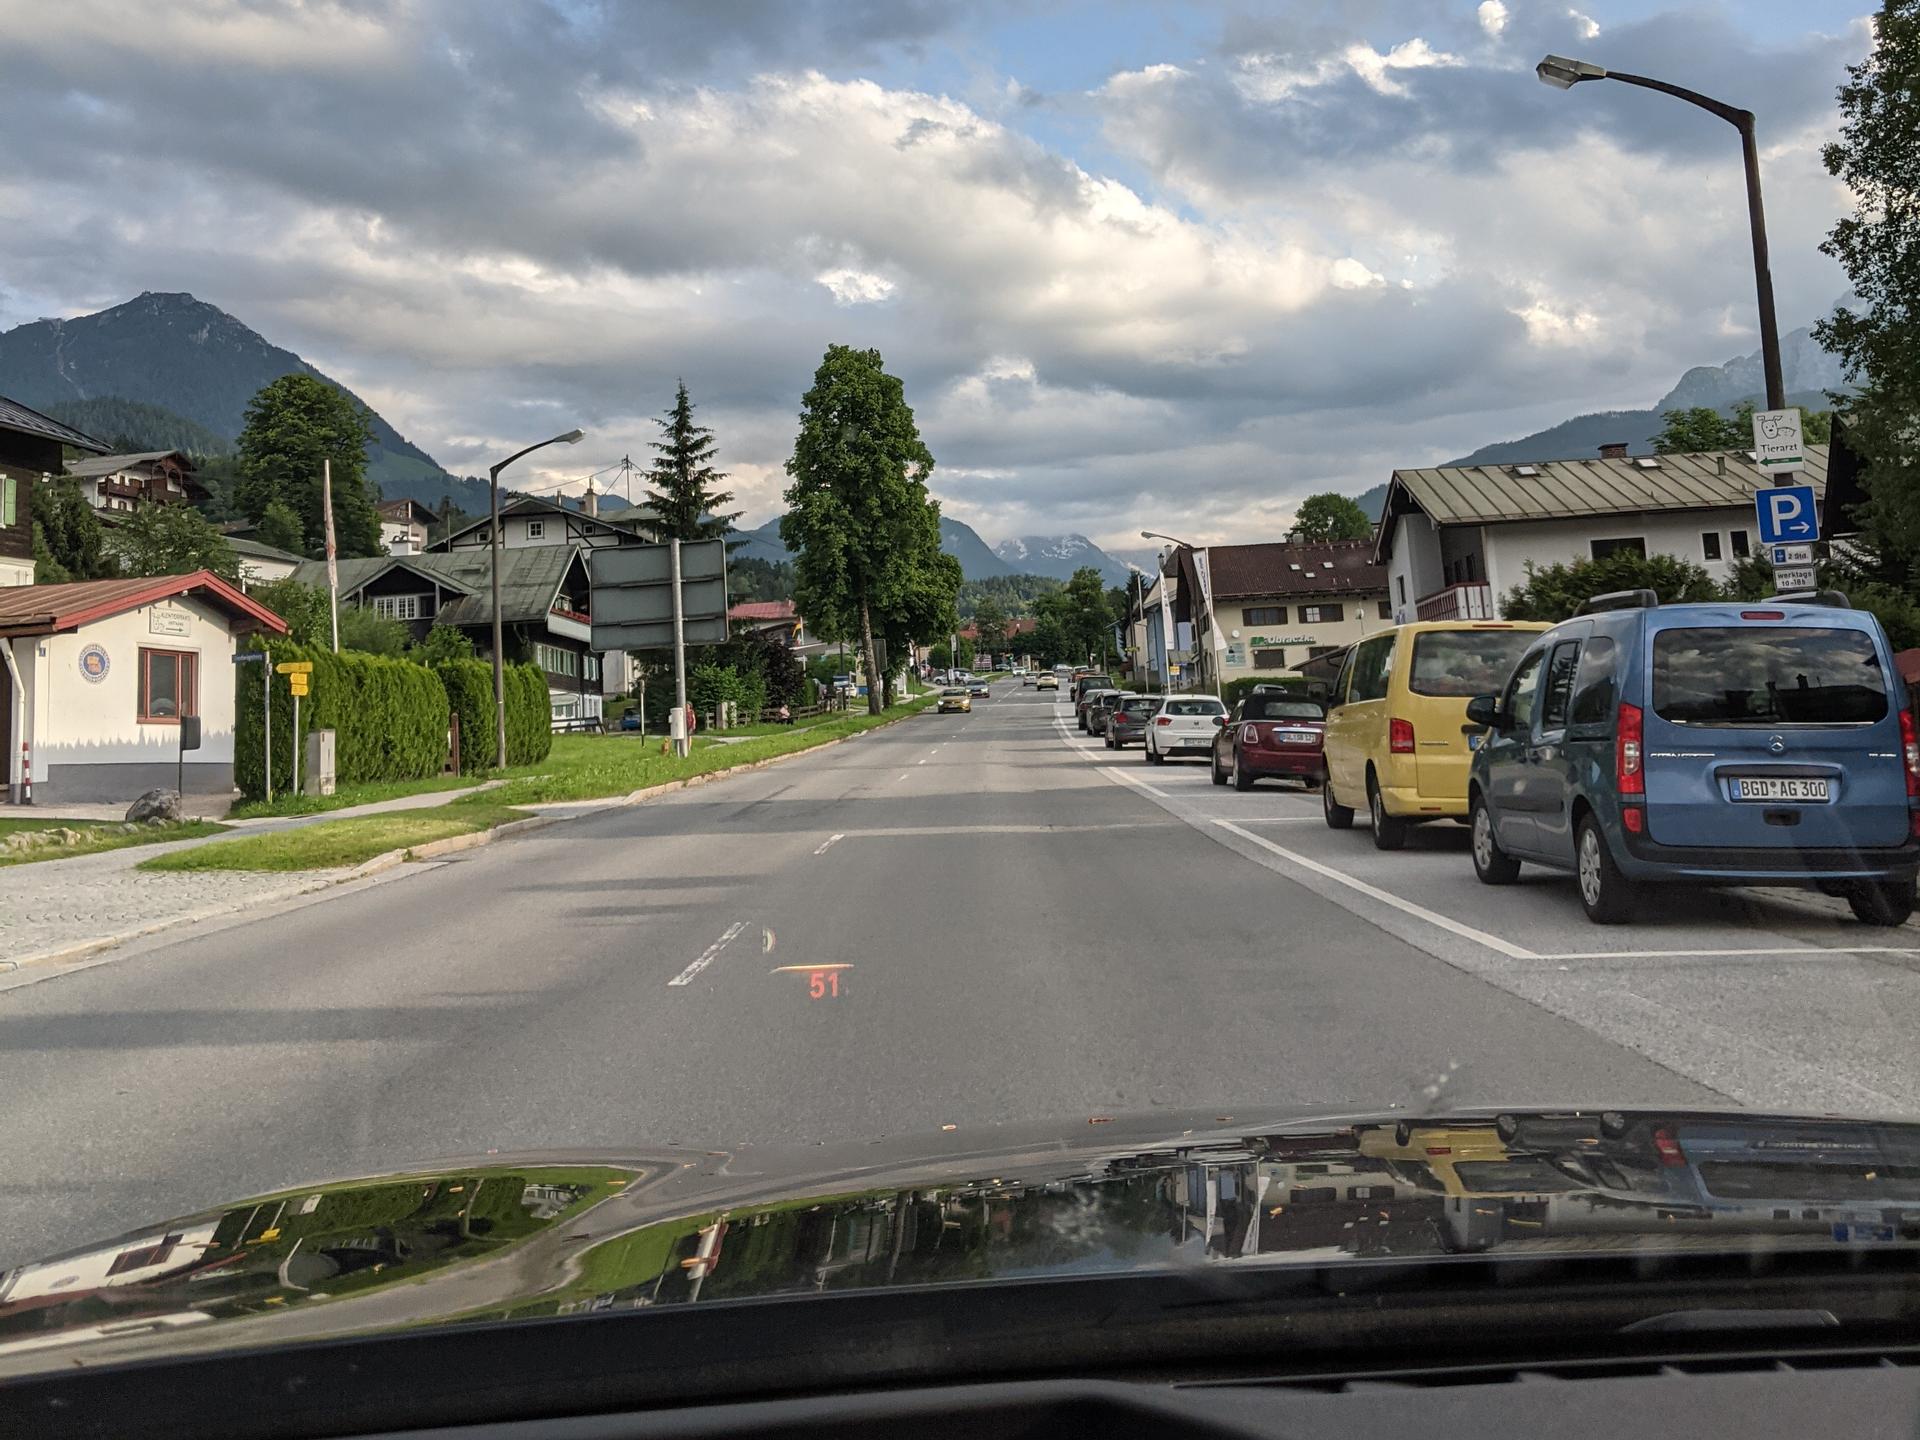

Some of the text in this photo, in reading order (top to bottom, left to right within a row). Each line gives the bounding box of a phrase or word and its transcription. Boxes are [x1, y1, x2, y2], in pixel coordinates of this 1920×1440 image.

[1760, 443, 1798, 453] Tierarzt
[1769, 494, 1802, 536] P
[1777, 571, 1812, 579] werktags
[1741, 780, 1827, 797] BGD AG 300
[809, 971, 839, 1000] 51
